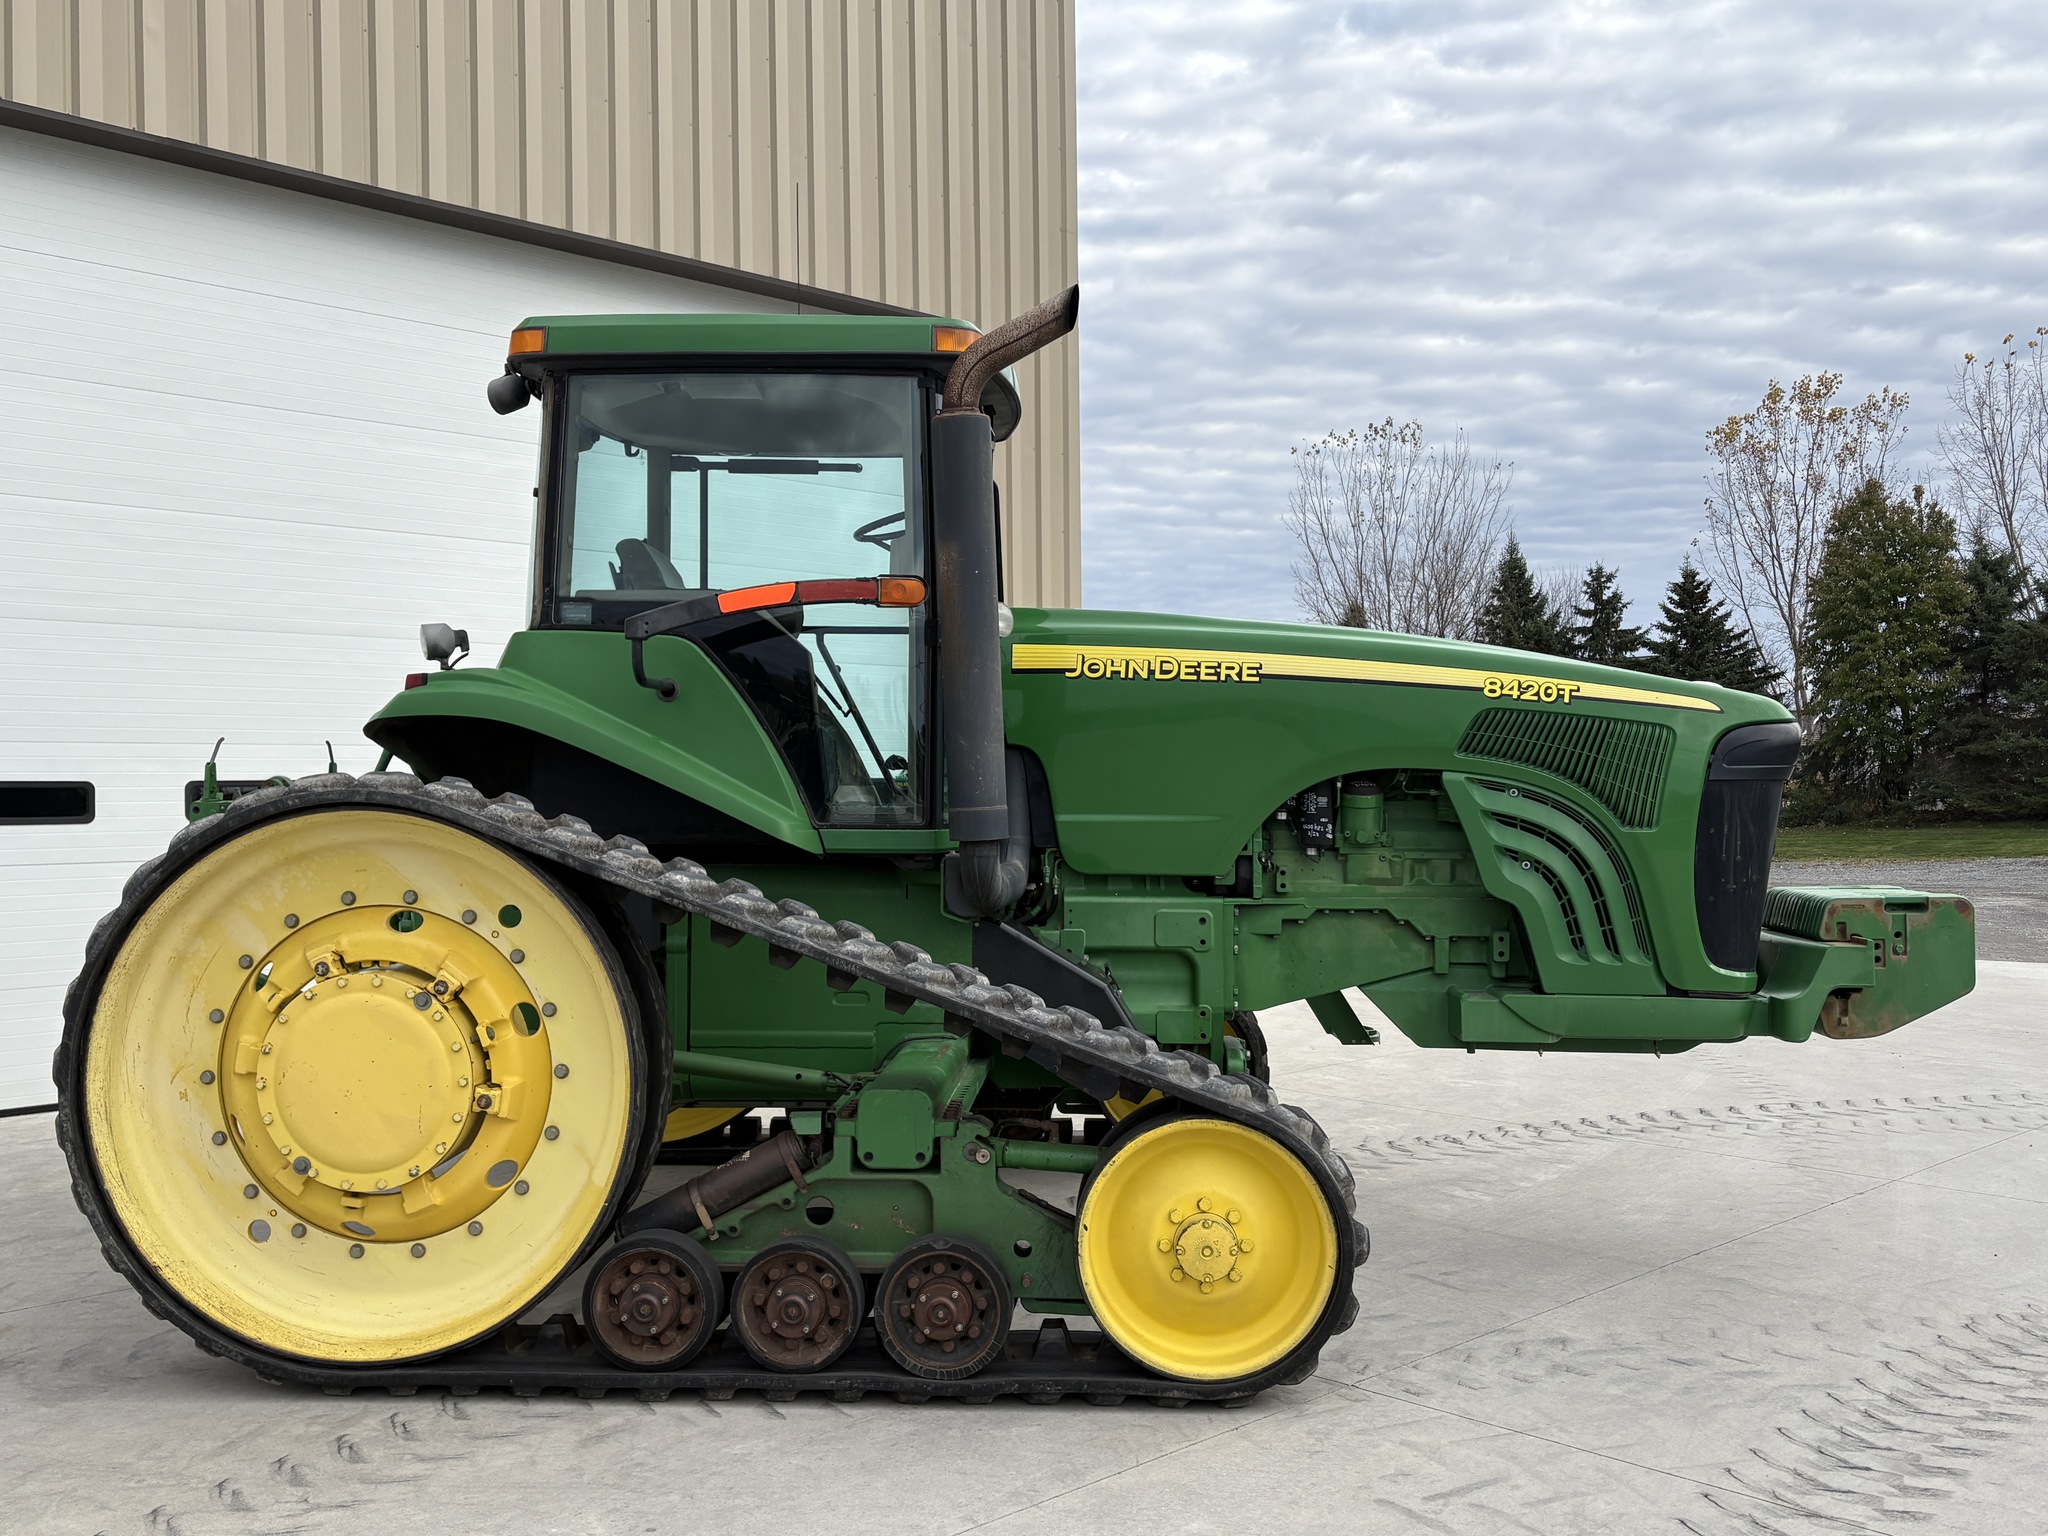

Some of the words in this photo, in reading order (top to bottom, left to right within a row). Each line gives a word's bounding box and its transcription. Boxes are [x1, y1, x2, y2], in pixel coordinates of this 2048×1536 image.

[1065, 654, 1149, 680] JOHN
[1153, 656, 1262, 682] DEERE
[1482, 677, 1580, 704] 8420T
